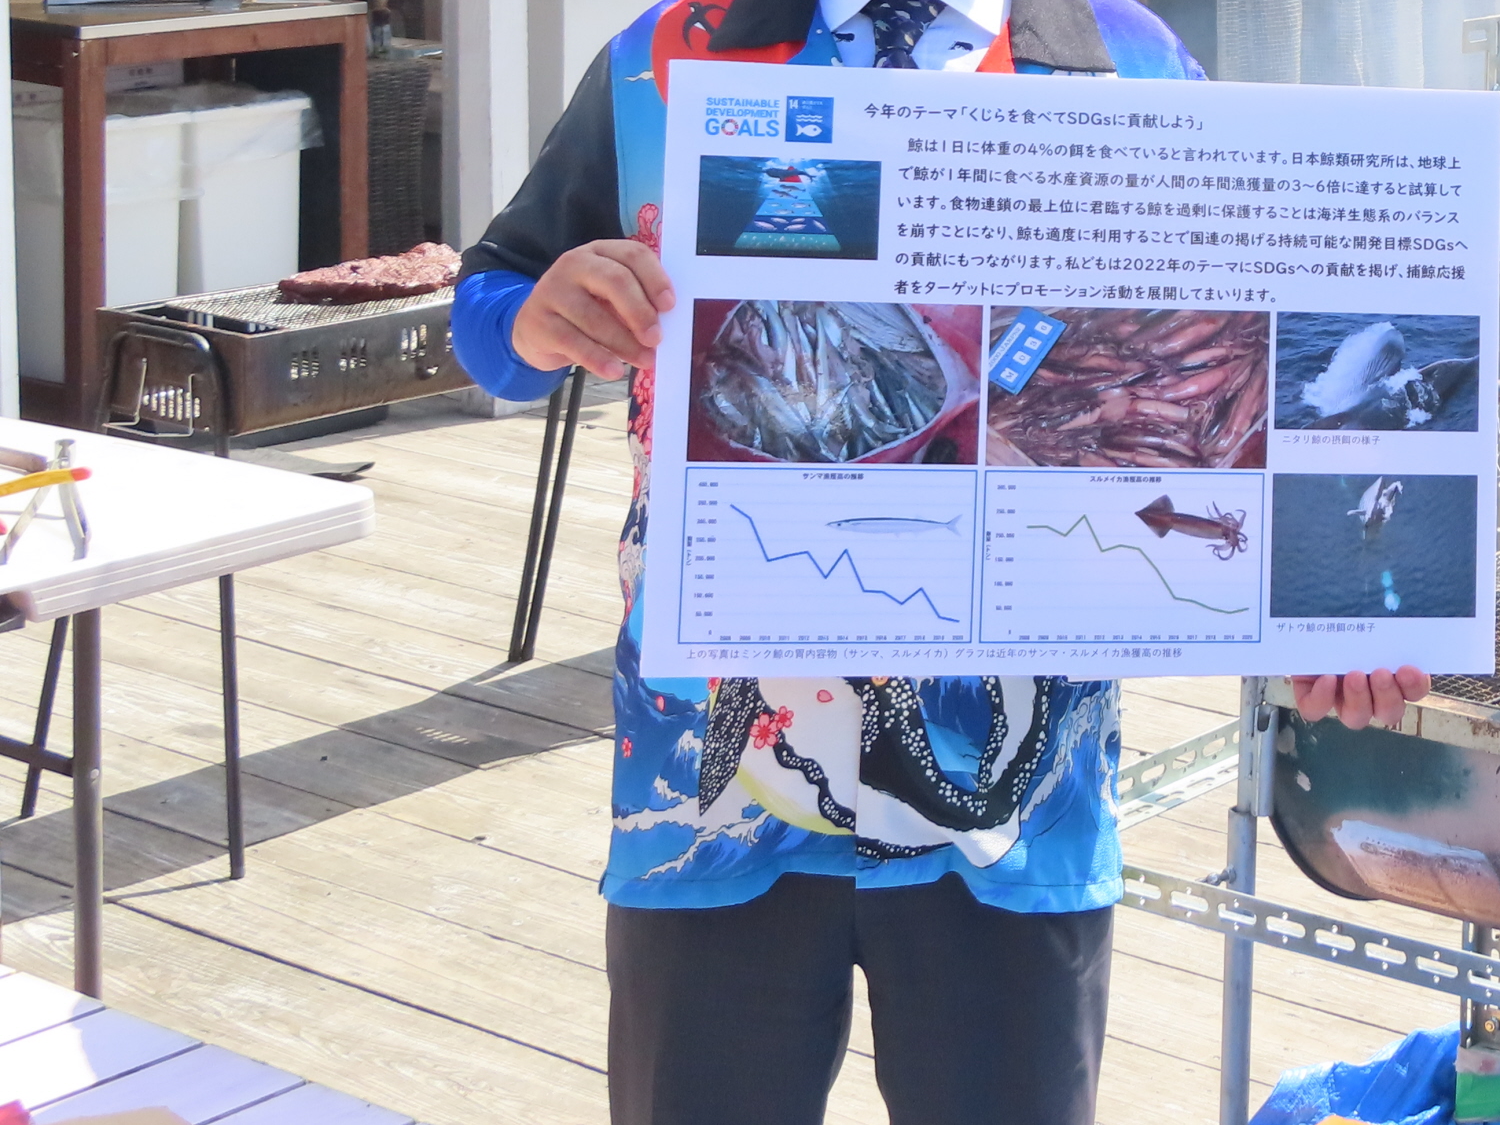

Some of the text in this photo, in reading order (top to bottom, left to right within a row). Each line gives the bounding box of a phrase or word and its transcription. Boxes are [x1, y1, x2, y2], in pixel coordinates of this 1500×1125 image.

[706, 97, 780, 109] SUSTAINABLE
[706, 108, 779, 118] DEVELOPMENT
[864, 103, 1204, 131] 今年のテーマ「くじらを食べてSDGsに貢献しよう」
[705, 118, 780, 138] GOALS
